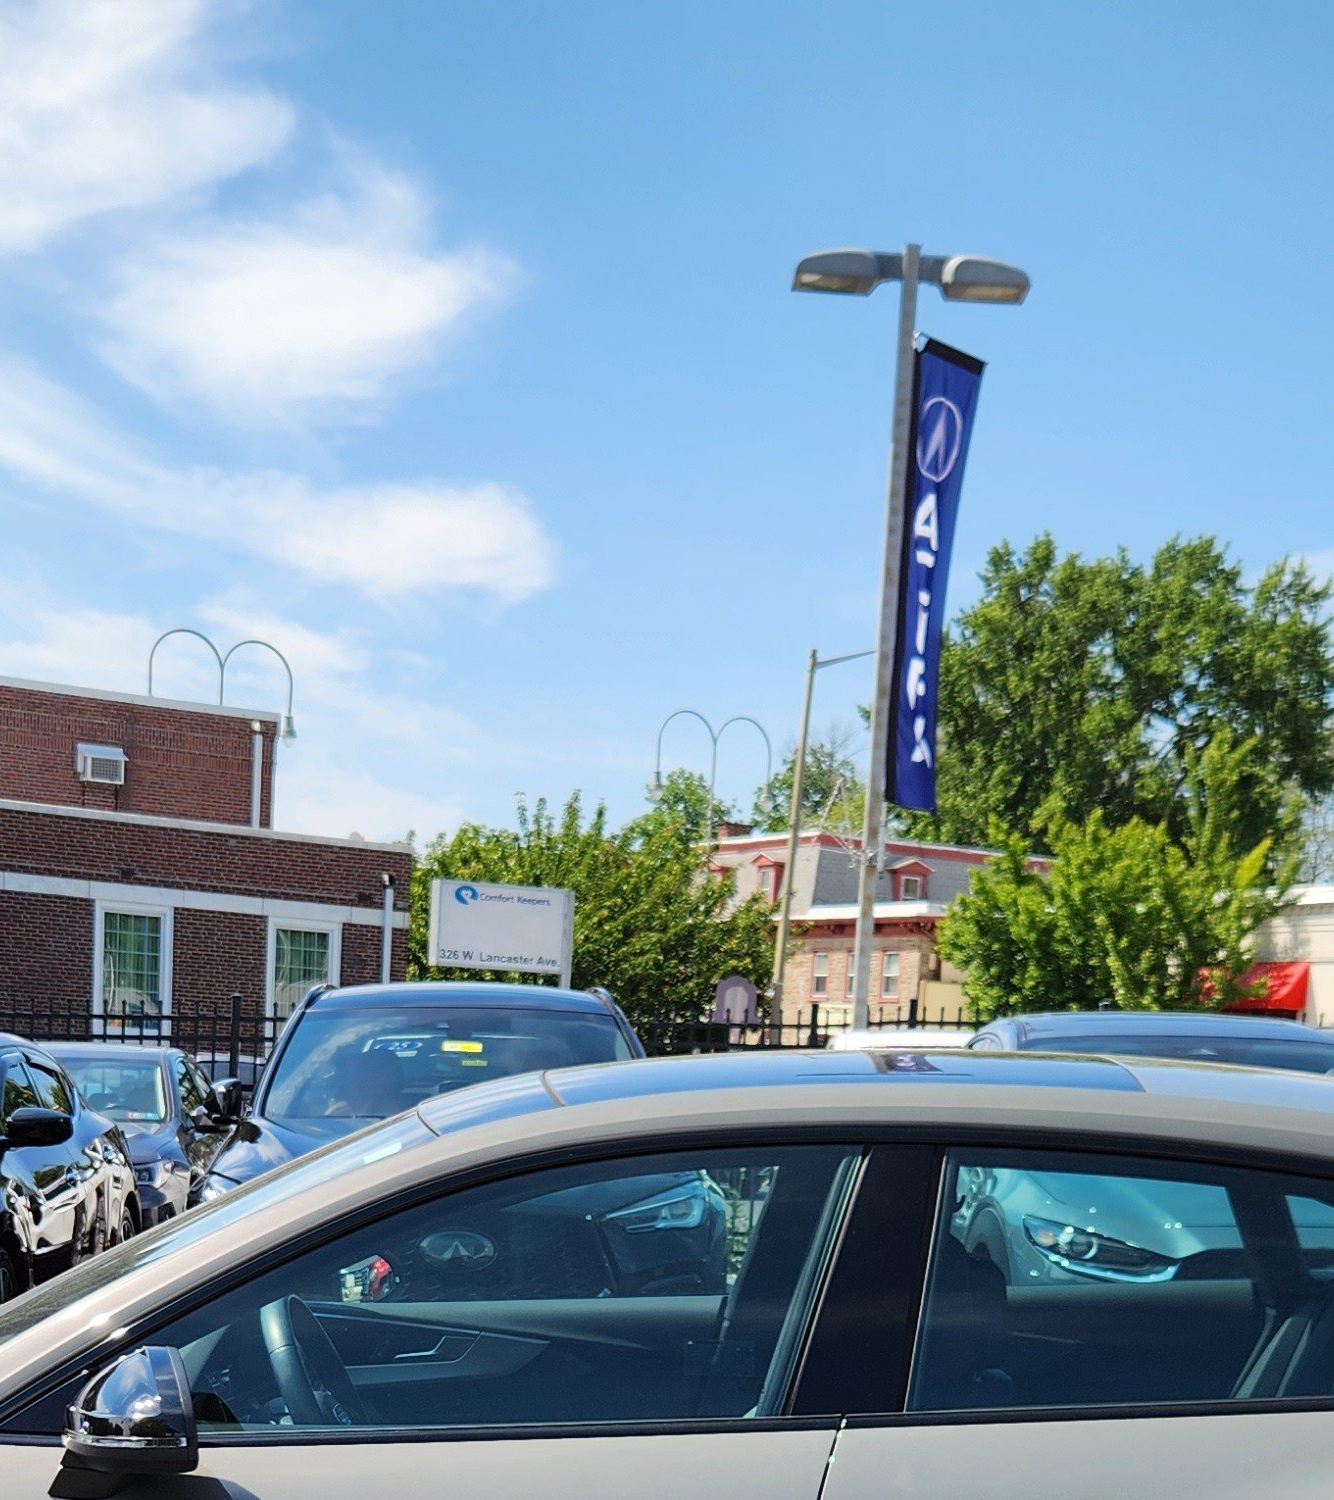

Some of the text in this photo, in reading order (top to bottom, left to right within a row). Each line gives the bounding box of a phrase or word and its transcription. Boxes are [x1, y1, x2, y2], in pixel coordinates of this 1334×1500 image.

[479, 892, 552, 908] Comfort Keepers
[439, 949, 459, 961] 326
[479, 951, 534, 965] Lancaster
